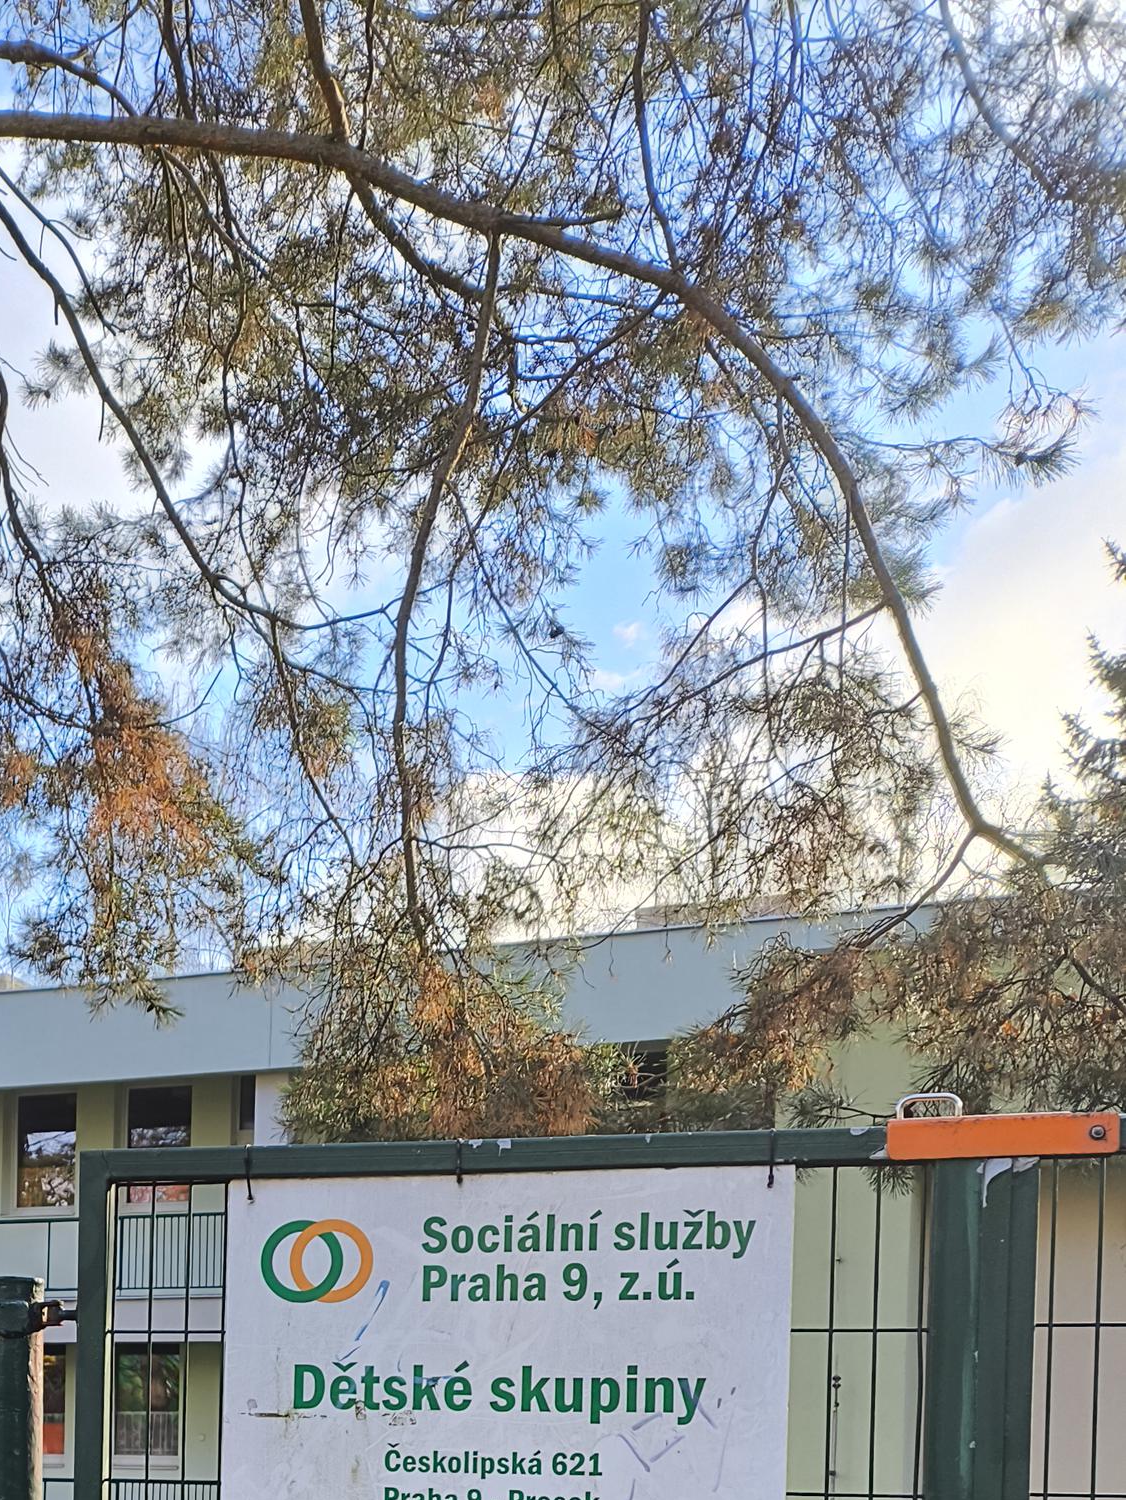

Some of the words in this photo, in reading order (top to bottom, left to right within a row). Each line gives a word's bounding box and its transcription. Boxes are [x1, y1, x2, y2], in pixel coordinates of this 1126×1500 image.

[421, 1211, 603, 1254] Sociální
[613, 1210, 757, 1259] služby
[421, 1265, 548, 1302] Praha
[561, 1262, 603, 1310] 9,
[618, 1258, 695, 1301] z.ú.
[292, 1361, 473, 1412] Dětské
[488, 1365, 707, 1425] skupiny
[384, 1442, 543, 1480] Českolipská
[551, 1452, 603, 1477] 621
